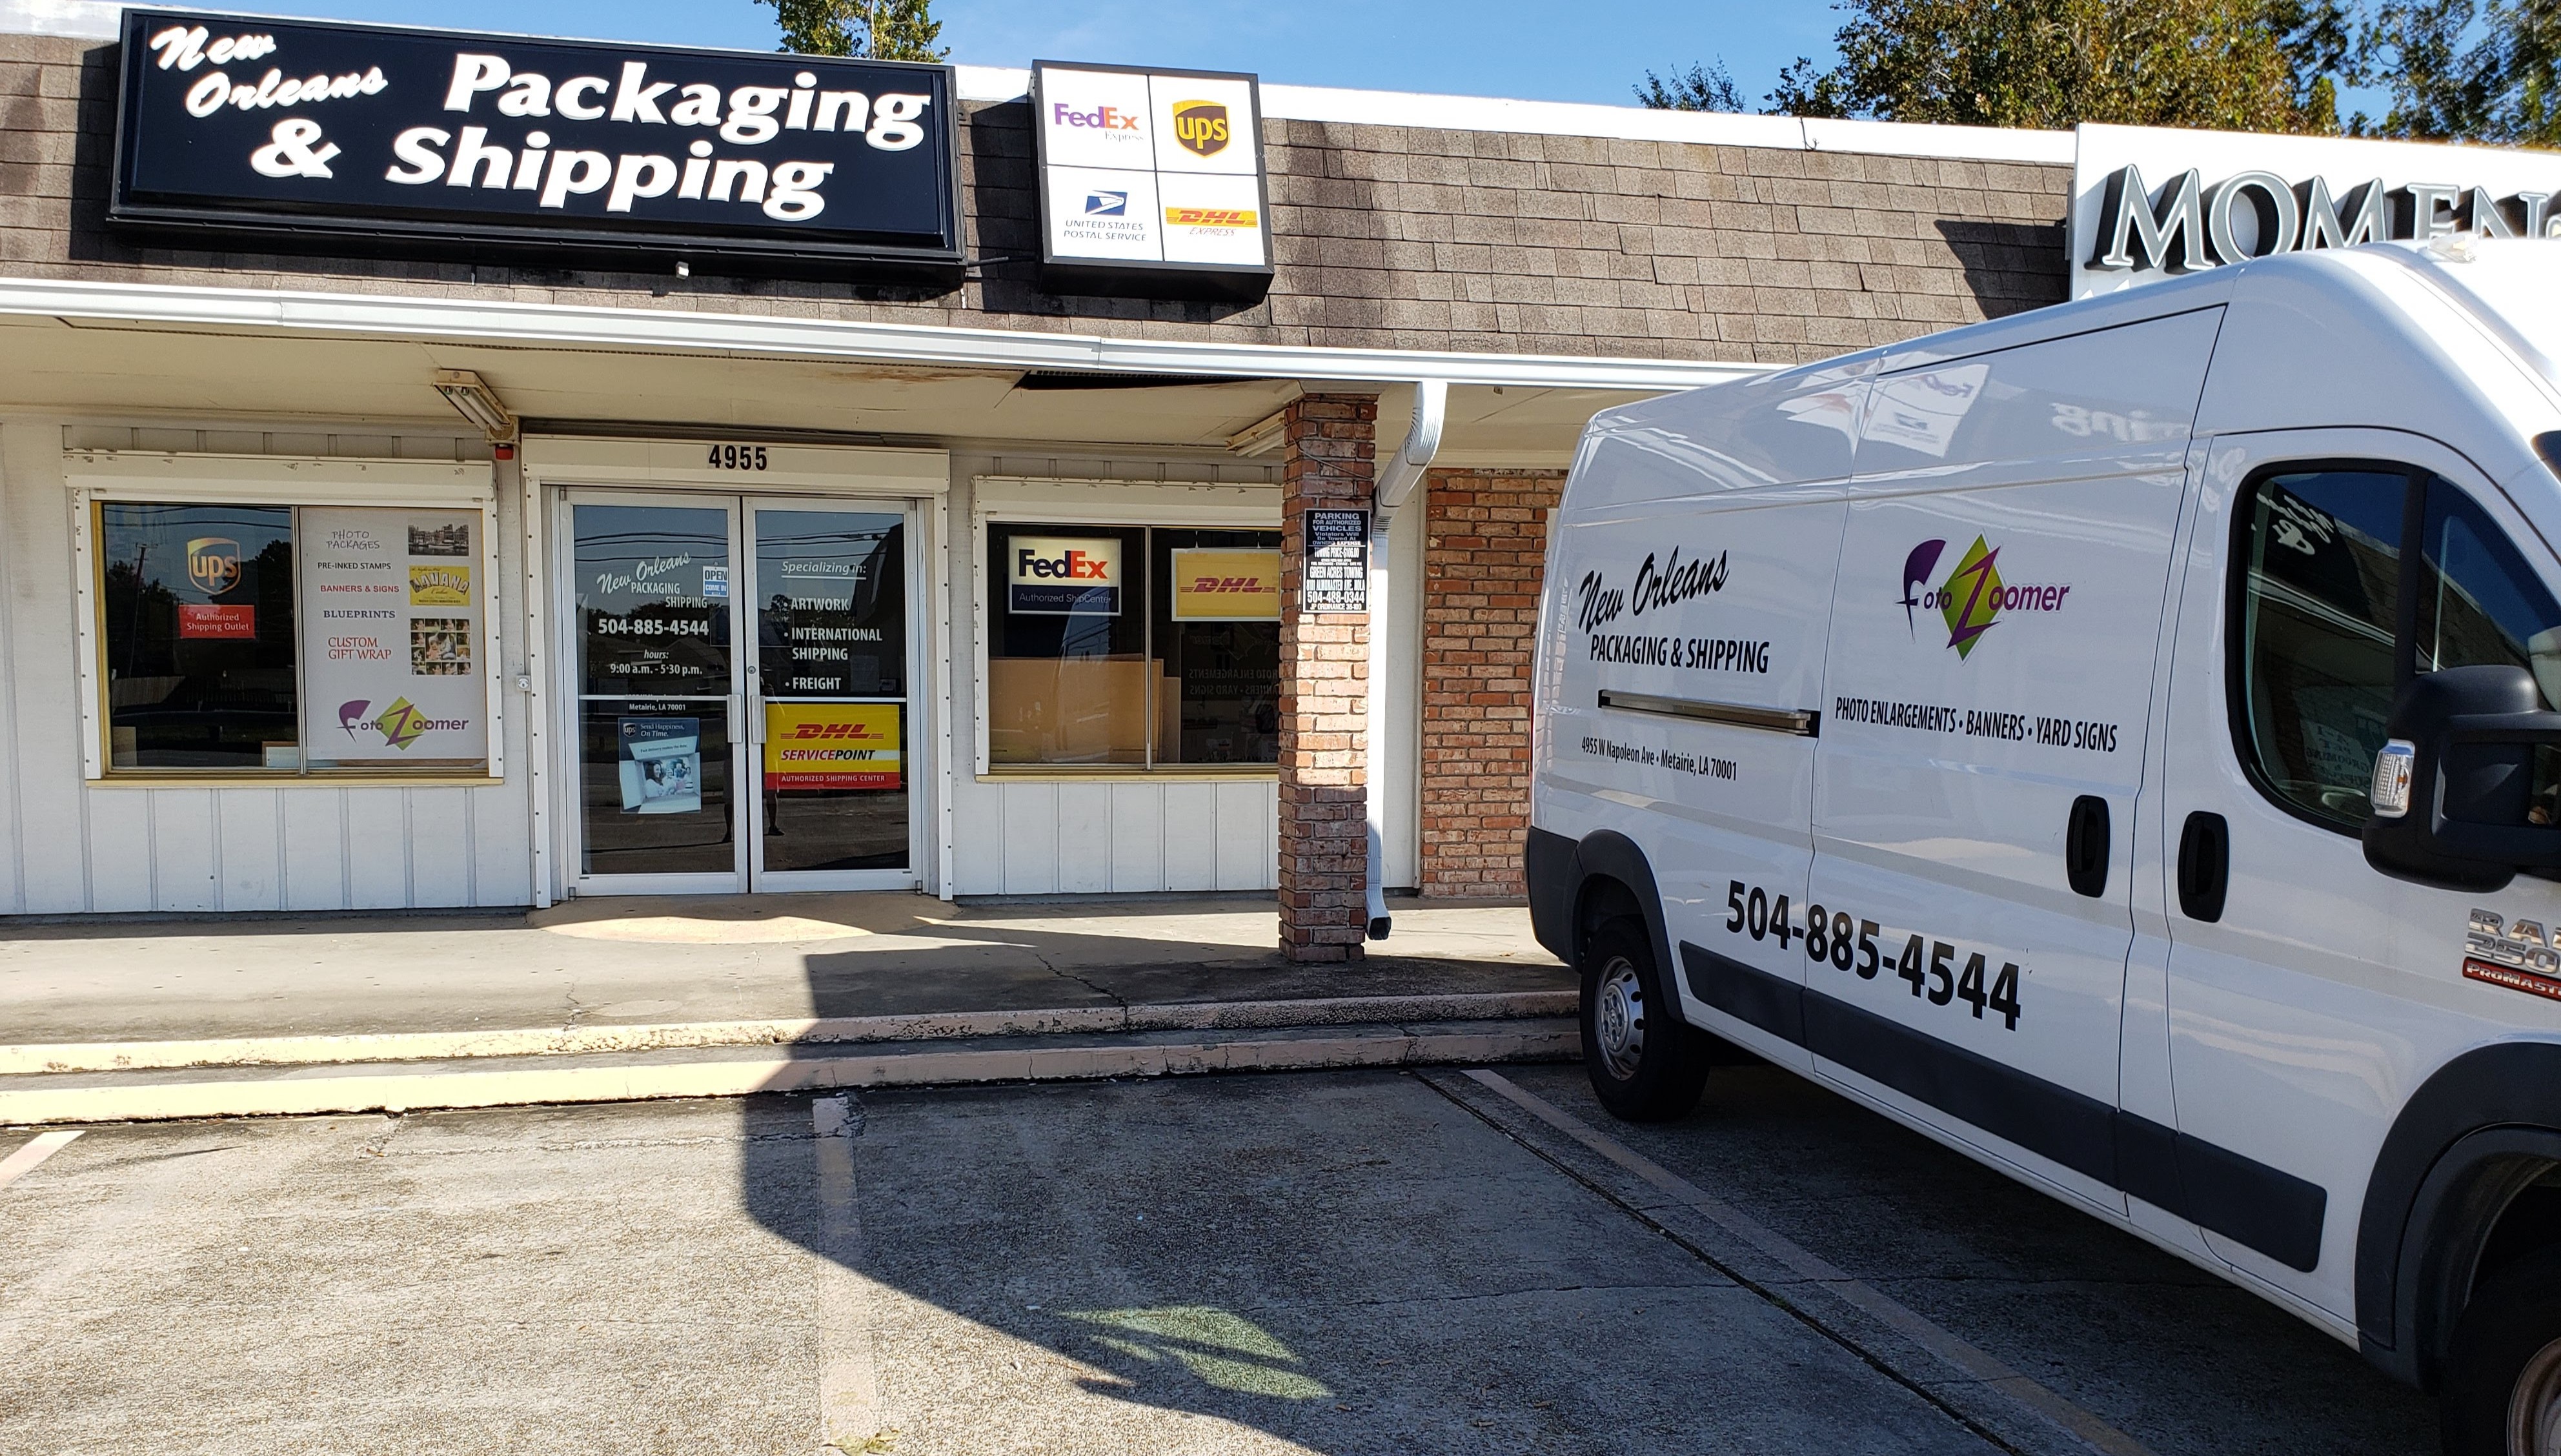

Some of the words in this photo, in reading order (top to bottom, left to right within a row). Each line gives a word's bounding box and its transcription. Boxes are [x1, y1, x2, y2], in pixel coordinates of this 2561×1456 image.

[150, 26, 276, 71] New
[186, 66, 388, 117] Orleans
[443, 54, 930, 151] Packaging
[1054, 103, 1140, 130] FedEx
[1177, 117, 1228, 150] ups
[250, 119, 341, 179] &
[385, 126, 834, 221] Shipping
[1178, 210, 1246, 225] DHL
[2102, 163, 2561, 269] MOMEN
[1066, 219, 1105, 230] UNITED
[1108, 222, 1144, 230] STATES
[1189, 227, 1237, 236] EXPRESS
[1064, 230, 1103, 239] POSTAL
[1106, 232, 1147, 241] SERVICE
[709, 445, 767, 470] 4955
[332, 529, 370, 540] PHOTO
[326, 540, 380, 550] PACKAGES
[1314, 547, 1330, 558] TOWING
[192, 556, 239, 587] ups
[781, 561, 850, 575] Specializing
[853, 563, 867, 573] in:
[1018, 549, 1108, 580] FedEx
[596, 573, 632, 594] New
[636, 552, 691, 581] Orleans
[705, 570, 727, 580] OPEN
[1310, 566, 1326, 578] GREEN
[1327, 566, 1342, 578] ACRES
[1343, 567, 1363, 578] TOWING
[631, 582, 680, 594] PACKAGING
[1193, 577, 1264, 593] DHL
[1579, 570, 1624, 634] New
[1632, 545, 1730, 616] Orleans
[665, 596, 707, 609] SHIPPING
[791, 598, 850, 611] ARTWORK
[1019, 593, 1064, 602] Authorized
[323, 610, 396, 619] BLUEPRINTS
[187, 622, 222, 632] Shipping
[224, 623, 249, 631] Outlet
[598, 618, 709, 636] 504-885-4544
[791, 627, 883, 642] INTERNATIONAL
[328, 637, 378, 647] CUSTOM
[328, 649, 354, 660] GIFT
[357, 649, 392, 660] WRAP
[643, 649, 669, 659] hours:
[792, 647, 848, 660] SHIPPING
[1590, 634, 1668, 666] PACKAGING
[1670, 638, 1683, 667] &
[1686, 638, 1770, 673] SHIPPING
[610, 663, 631, 674] 9:00
[633, 665, 653, 674] a.m.
[682, 665, 703, 676] p.m.
[793, 677, 841, 690] FREIGHT
[624, 727, 636, 736] ups
[795, 723, 870, 739] DHL
[1835, 696, 1868, 723] PHOTO
[1870, 700, 1957, 733] ENLARGEMENTS
[1966, 710, 2025, 741] BANNERS
[2036, 716, 2071, 747] YARD
[2074, 721, 2118, 753] SIGNS
[781, 749, 875, 760] SERVICEPOINT
[1581, 736, 1597, 754] 4955
[1599, 738, 1606, 756] W
[1606, 740, 1640, 765] Napoleon
[1641, 745, 1654, 765] Ave
[1661, 749, 1697, 776] Metairie,
[1698, 754, 1708, 776] LA
[1710, 758, 1737, 781] 70001
[1726, 880, 2021, 1032] 504-885-4544
[2465, 932, 2561, 974] 250
